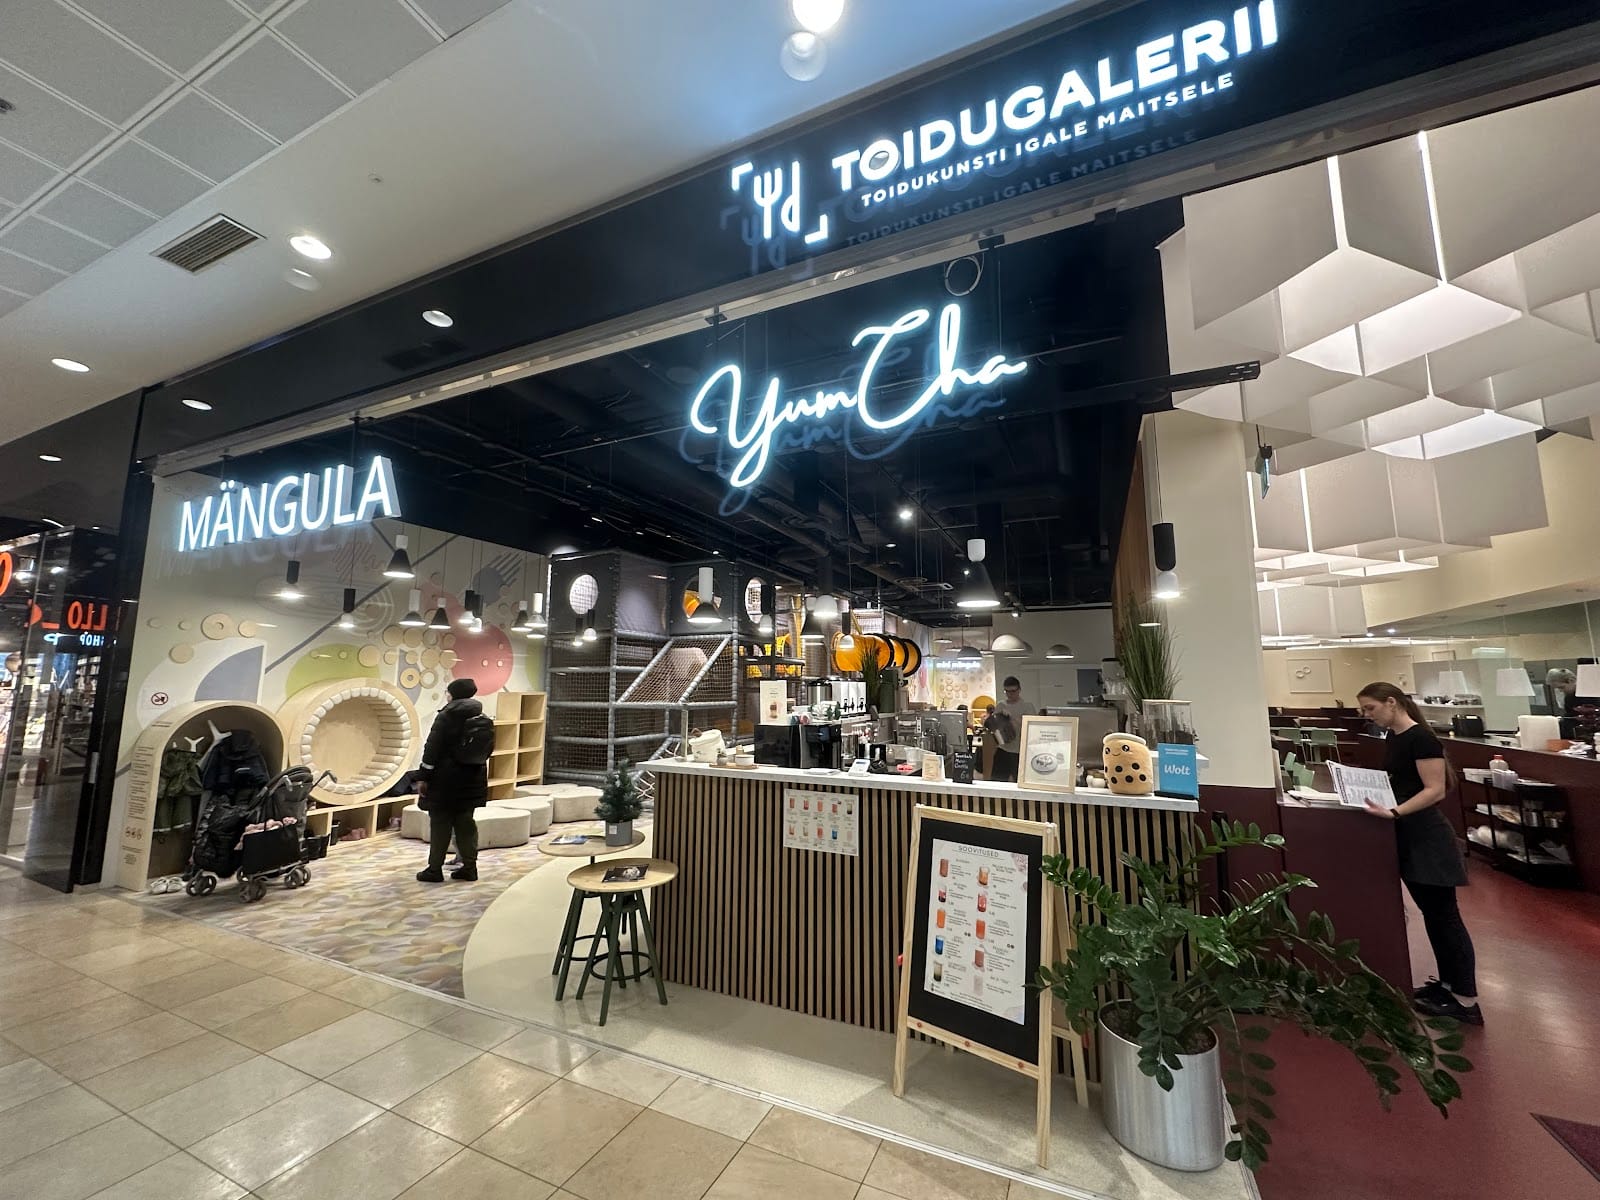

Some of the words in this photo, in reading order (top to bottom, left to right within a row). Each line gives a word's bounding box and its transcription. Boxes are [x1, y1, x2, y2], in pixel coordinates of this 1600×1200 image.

[831, 1, 1278, 191] TOIDUGALERII
[861, 149, 1006, 207] TOIDUKUNSTI
[1016, 121, 1087, 156] IGALE
[1098, 72, 1234, 129] MAITSELE
[178, 455, 398, 552] MÄNGULA
[1164, 763, 1192, 776] Wolt
[958, 845, 999, 858] SOOVITUSED
